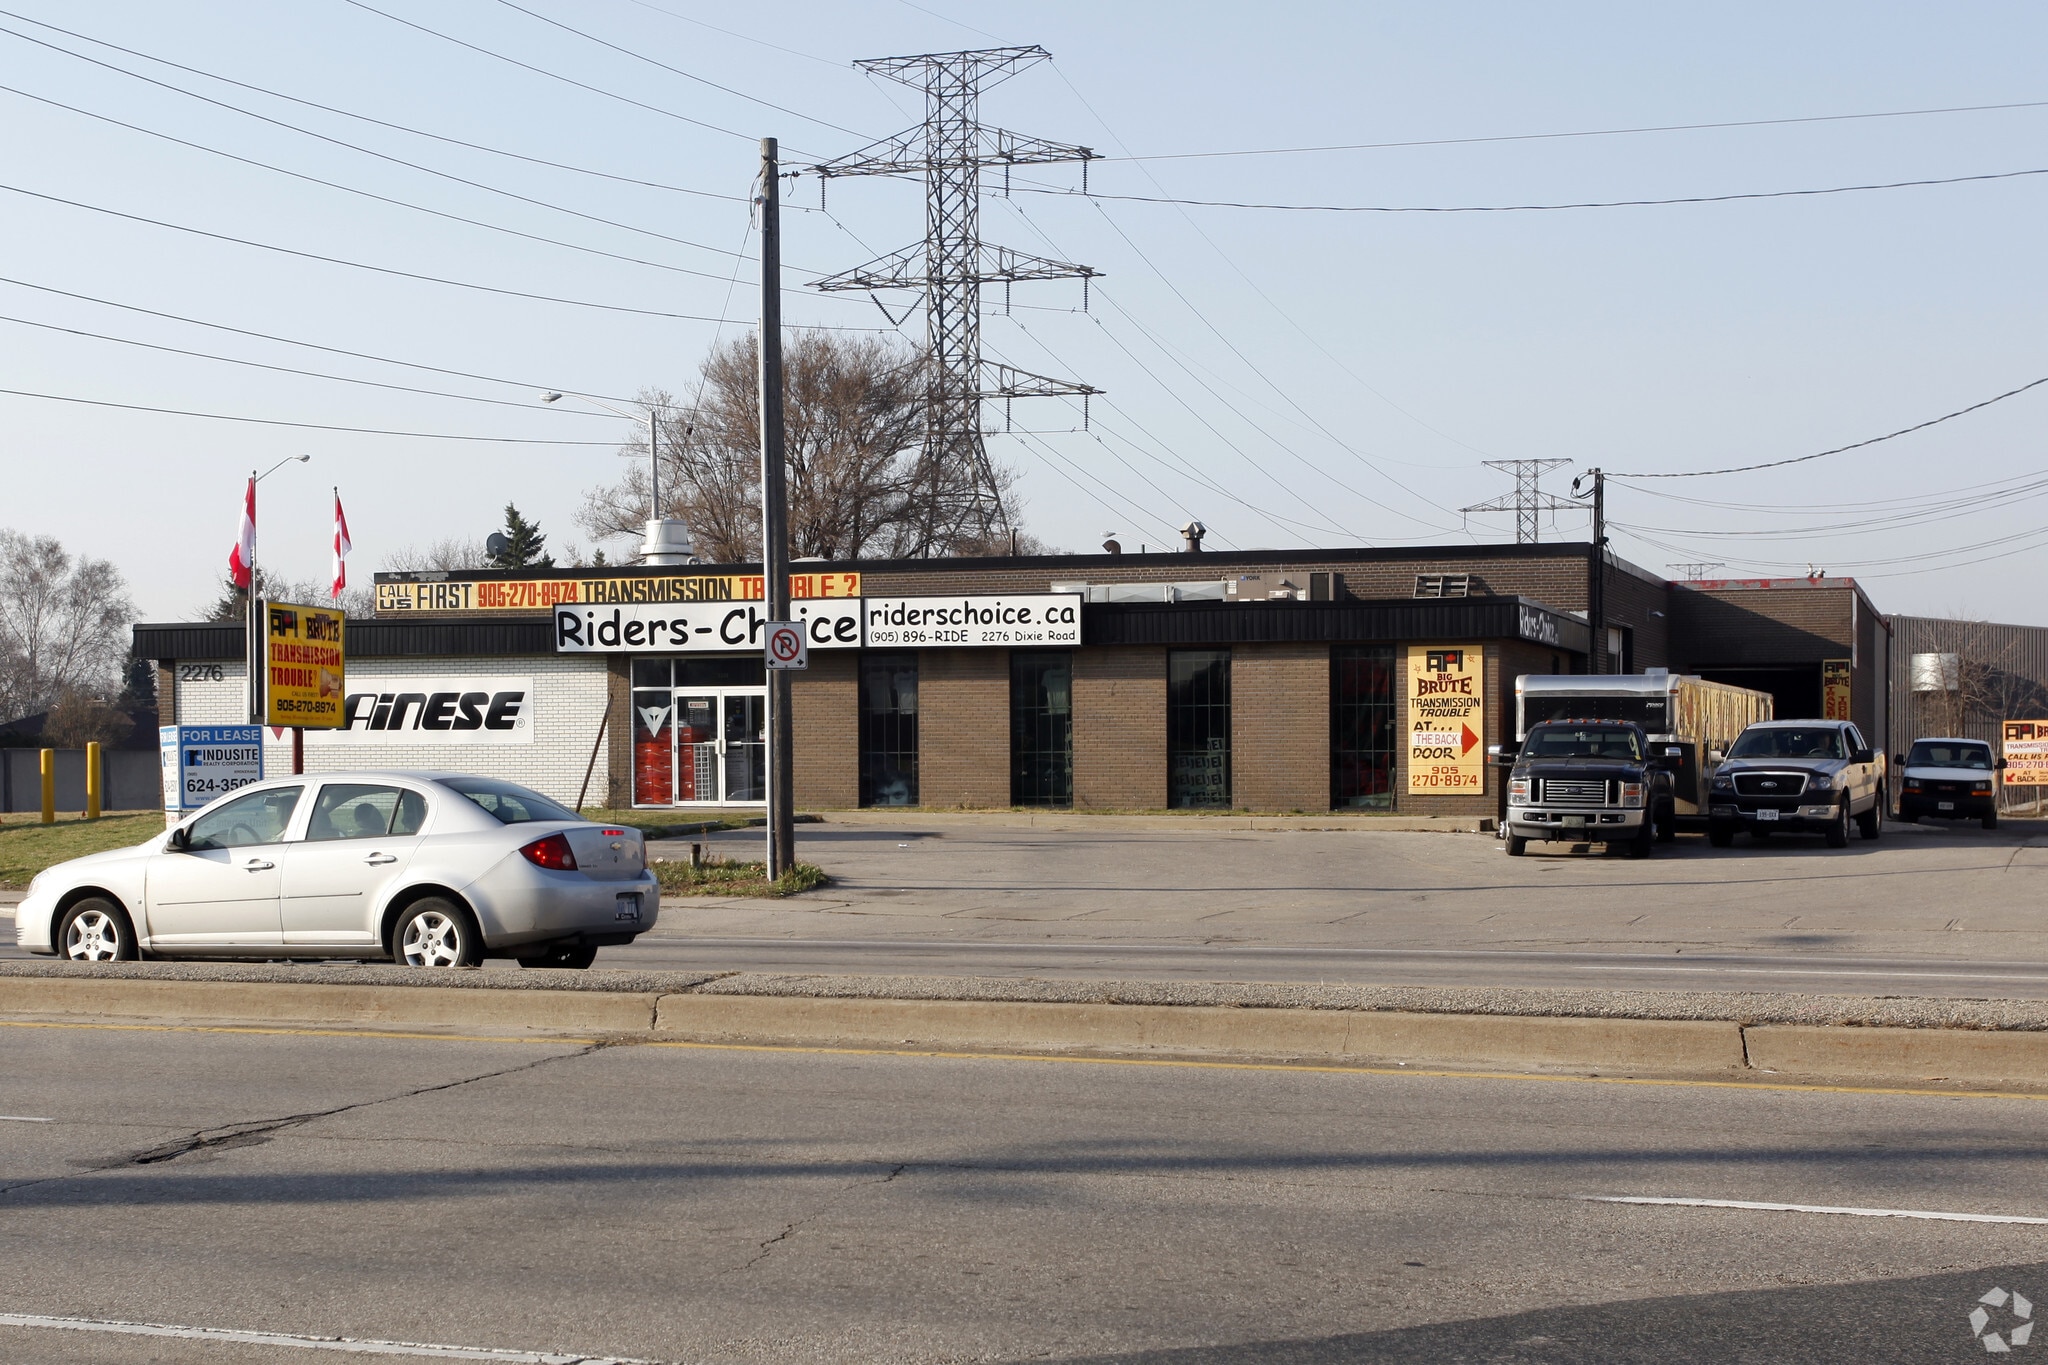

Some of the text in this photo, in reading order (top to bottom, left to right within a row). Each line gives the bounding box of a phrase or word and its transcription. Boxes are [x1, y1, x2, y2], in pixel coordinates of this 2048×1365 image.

[379, 585, 412, 598] CALL
[417, 583, 473, 609] FIRST
[582, 576, 732, 604] TRANSMISSION
[739, 573, 858, 599] TRBLE?
[379, 599, 412, 610] US
[869, 600, 1076, 627] riderschoice.ca
[305, 616, 341, 642] BRUTE
[557, 605, 858, 648] Riders-Chce
[870, 629, 1076, 643] (905) 896-RIDE 2276 Dixie Road
[271, 642, 341, 667] TRANSMISSION
[180, 664, 223, 682] 2276
[271, 666, 318, 688] TROUBLE?
[1436, 673, 1453, 682] BIG
[1416, 676, 1473, 698] BRUTE
[276, 698, 337, 714] 905-270-8974
[1410, 697, 1481, 709] TRANSMISSION
[318, 691, 525, 731] AINESE
[1419, 708, 1471, 718] TROUBLE
[181, 729, 260, 742] FOR LEASE
[1415, 733, 1459, 745] THE BACK
[202, 748, 259, 761] INDUSITE
[1412, 747, 1456, 760] DOOR
[1431, 766, 1459, 775] 905
